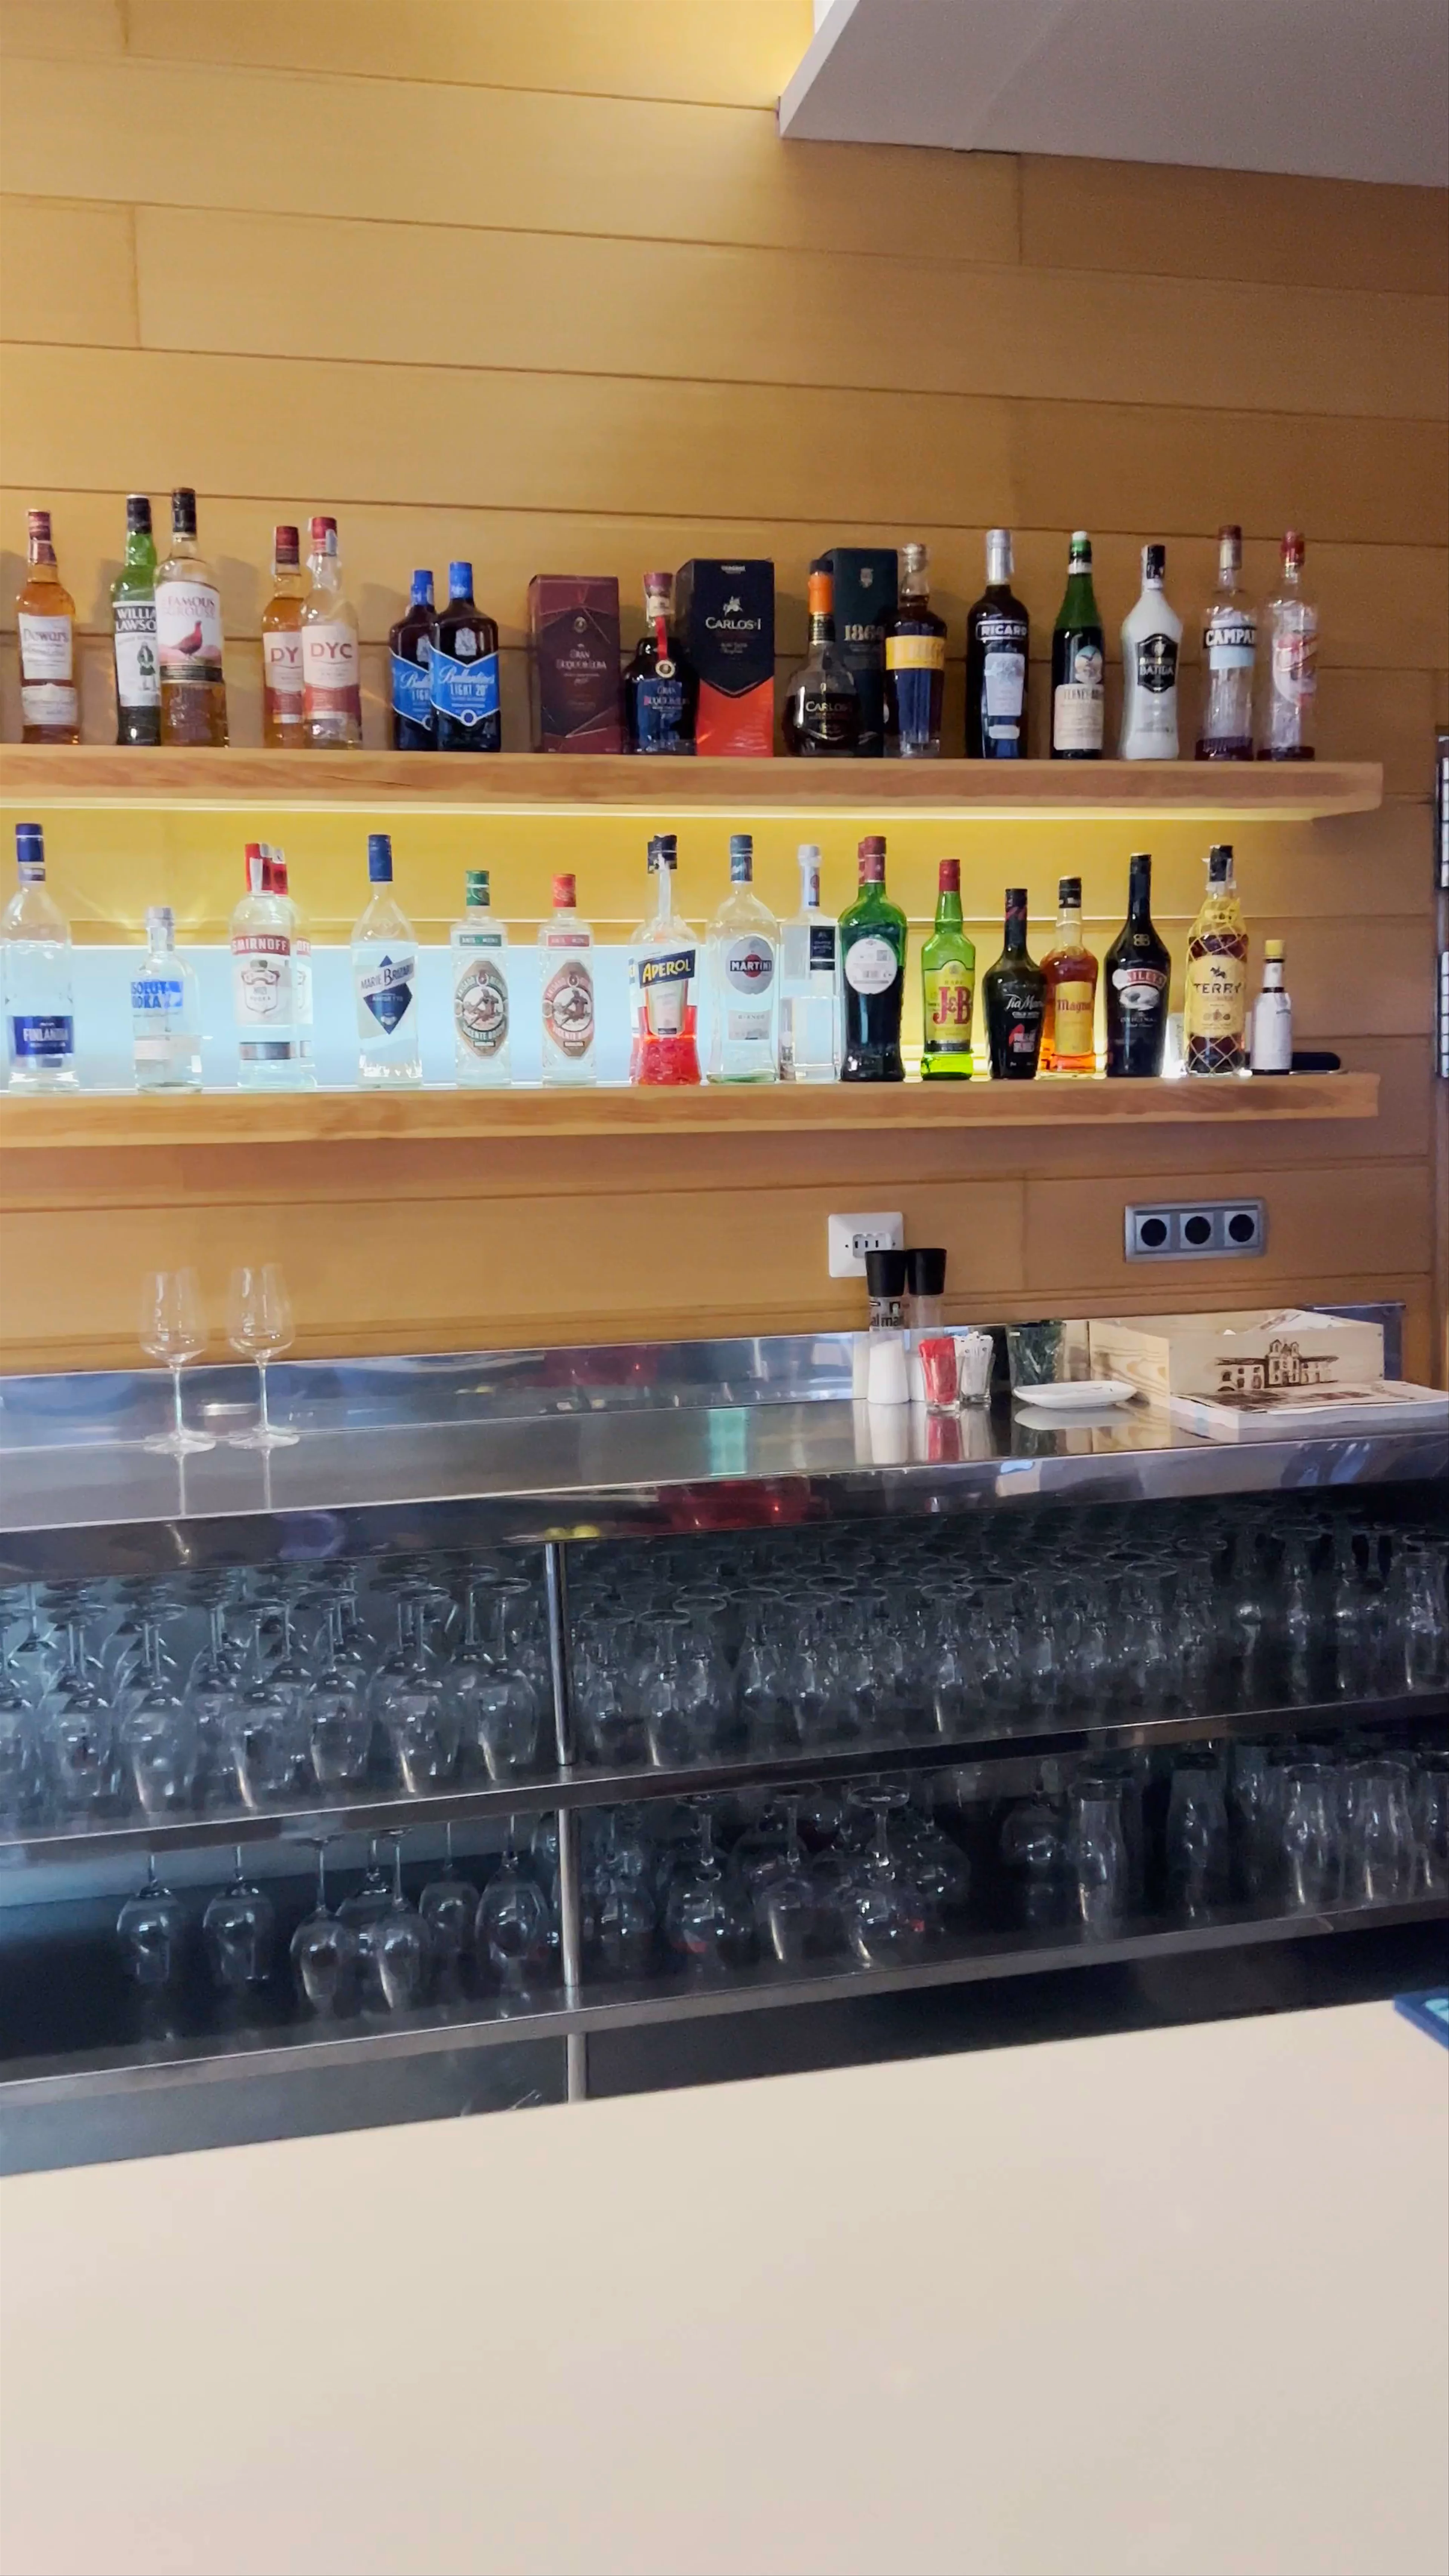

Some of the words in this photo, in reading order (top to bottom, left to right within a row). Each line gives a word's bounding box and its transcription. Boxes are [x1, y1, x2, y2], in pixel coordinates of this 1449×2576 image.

[117, 608, 155, 619] WILLIA
[116, 620, 156, 631] LAWSO
[981, 624, 1026, 635] RICARD
[1206, 628, 1254, 646] CAMPA
[271, 647, 298, 663] DY
[311, 642, 353, 658] DYC
[1140, 665, 1174, 675] BATIDA
[412, 689, 430, 701] LIGH
[232, 937, 287, 951] SMIRNOFF
[642, 958, 691, 983] APEROL
[731, 961, 771, 971] MARTINI
[1127, 970, 1164, 984] AILEYS
[1193, 983, 1241, 993] TERRY
[932, 986, 971, 1024] J&B
